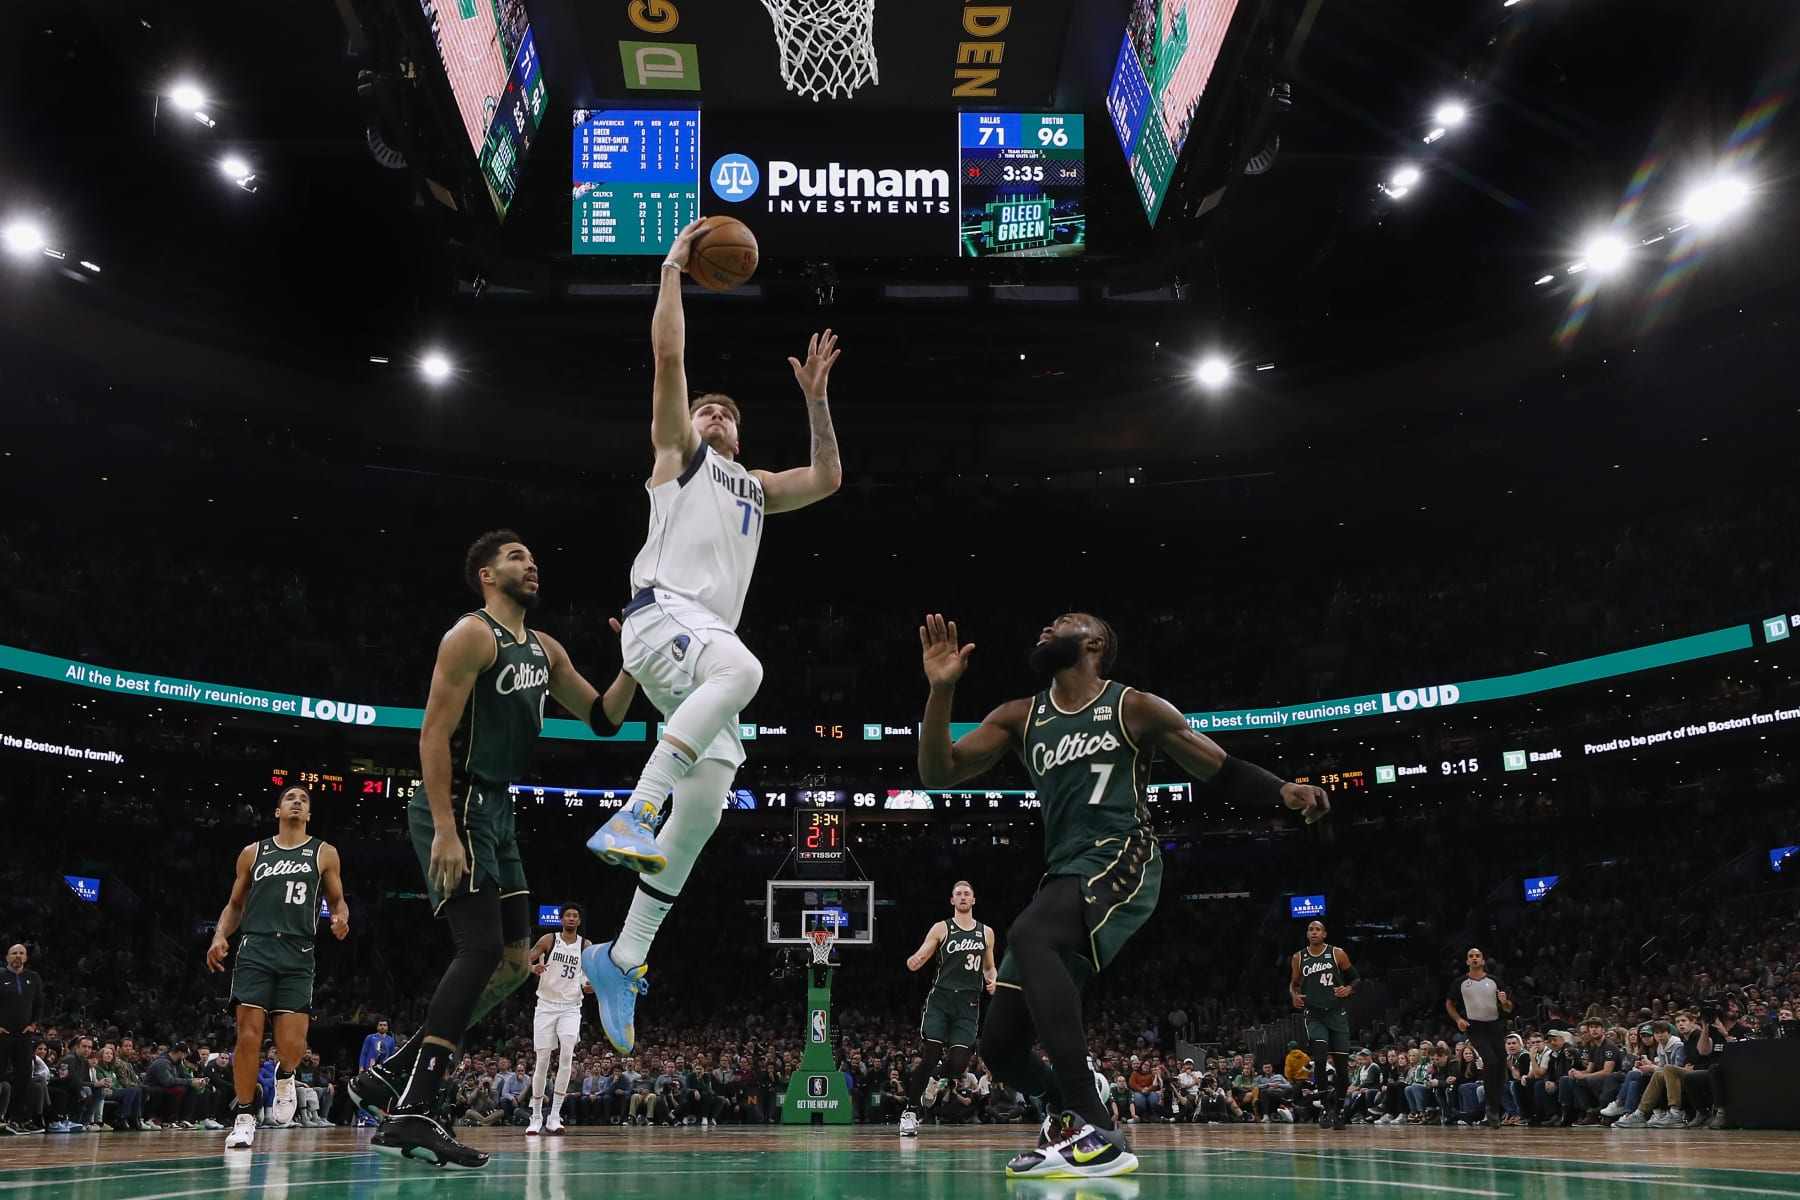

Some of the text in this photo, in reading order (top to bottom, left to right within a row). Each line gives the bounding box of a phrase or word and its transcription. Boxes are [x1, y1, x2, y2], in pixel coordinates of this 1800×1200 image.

[952, 0, 1012, 96] DEN
[1042, 117, 1064, 125] BOSTON
[979, 127, 1005, 145] 71
[1038, 128, 1068, 146] 96
[768, 161, 949, 197] Putnam
[1003, 166, 1044, 181] 3:35
[1060, 169, 1077, 177] 3rd
[768, 200, 950, 213] INVESTMENTS
[1001, 204, 1041, 223] BLEED
[998, 220, 1044, 241] GREEN
[712, 464, 763, 507] DALLAS
[496, 662, 549, 695] Celtics
[65, 665, 376, 725] All the best family reunions get LOUD
[1038, 704, 1046, 714] 6
[1093, 706, 1112, 715] VISTA
[1187, 684, 1460, 728] the best family reunions get LOUD
[1093, 713, 1112, 721] PRINT
[760, 725, 787, 735] Bank
[815, 725, 843, 739] 9:15
[865, 725, 912, 737] TD Bank
[1584, 706, 1800, 754] Proud to be part of the Boston fan fam
[4, 735, 22, 748] the
[24, 738, 62, 754] Boston
[64, 746, 82, 758] fan
[84, 748, 124, 764] family.
[1032, 730, 1120, 776] Celtics
[1506, 749, 1562, 767] TD Bank
[1378, 764, 1427, 781] TD Bank
[1441, 758, 1479, 775] 9:15
[272, 776, 283, 786] 96
[332, 782, 342, 792] 71
[300, 772, 318, 782] 3:35
[1088, 763, 1115, 805] 7
[1321, 774, 1340, 784] 3:35
[1353, 778, 1364, 786] 71
[363, 780, 383, 793] 21
[565, 798, 583, 807] 7/22
[600, 800, 622, 808] 28/53
[766, 793, 786, 806] 71
[854, 793, 876, 806] 96
[1172, 793, 1182, 801] 29
[812, 814, 838, 826] 3:34
[807, 826, 836, 848] 21
[254, 860, 312, 881] Celtics
[284, 880, 308, 904] 13
[946, 938, 984, 954] Celtics
[552, 952, 579, 966] DALLAS
[964, 954, 981, 972] 30
[560, 964, 576, 980] 35
[1302, 962, 1333, 976] Celtics
[1320, 973, 1334, 986] 42
[796, 1100, 838, 1108] GET THE NEW APP
